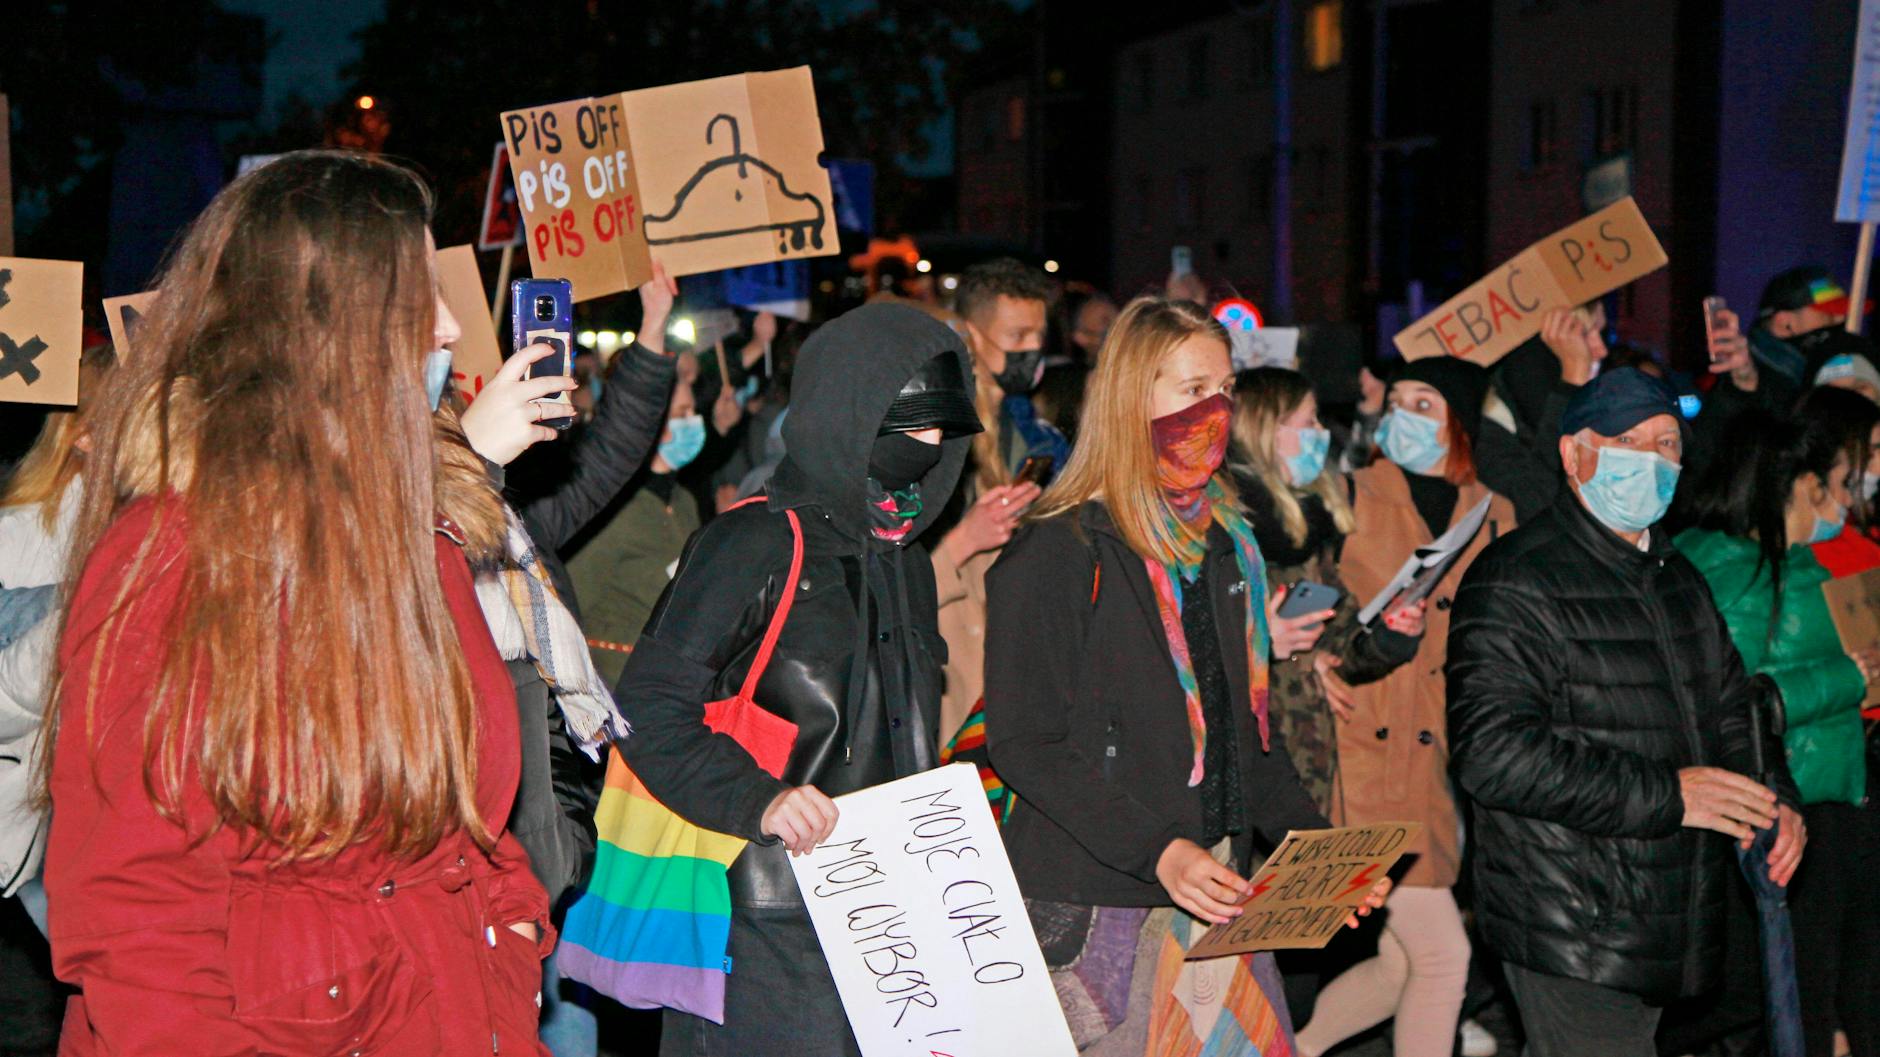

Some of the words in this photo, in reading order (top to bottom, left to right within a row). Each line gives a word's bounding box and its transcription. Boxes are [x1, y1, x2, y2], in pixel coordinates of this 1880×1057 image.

[576, 104, 620, 150] OFF
[583, 150, 628, 200] OFF
[592, 194, 637, 243] OFF
[1560, 219, 1632, 284] PiS
[813, 837, 887, 898] MÓJ
[1268, 837, 1300, 868] I
[900, 788, 981, 873] MOJE
[942, 879, 1024, 985] CIAŁO
[1263, 862, 1366, 902] ABORT
